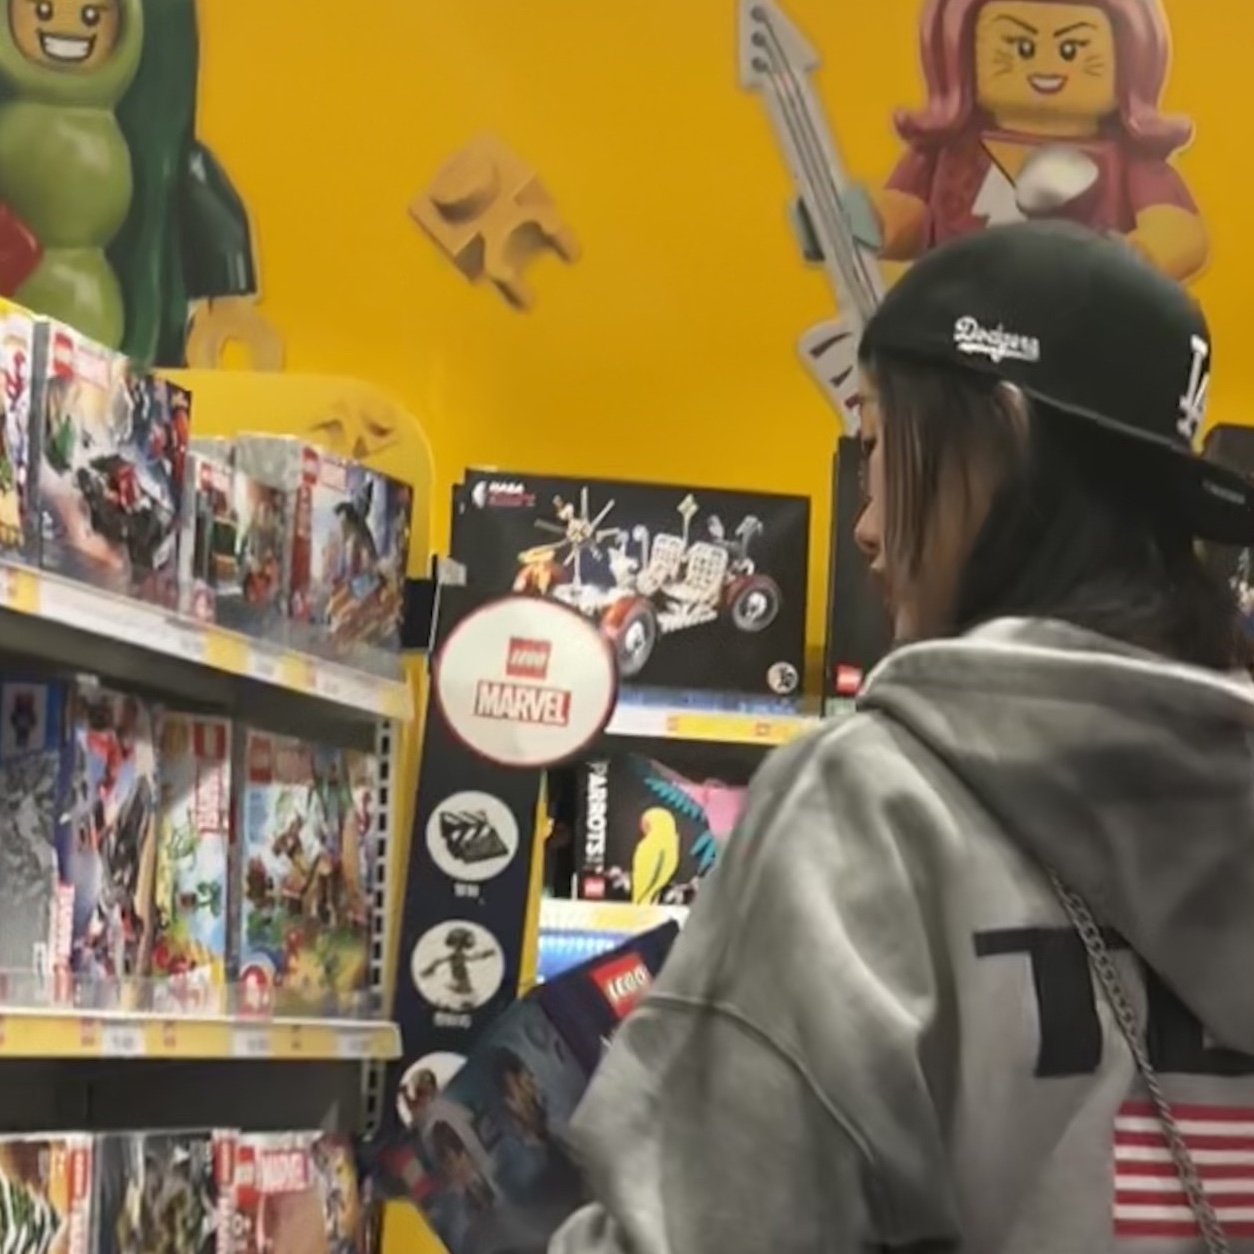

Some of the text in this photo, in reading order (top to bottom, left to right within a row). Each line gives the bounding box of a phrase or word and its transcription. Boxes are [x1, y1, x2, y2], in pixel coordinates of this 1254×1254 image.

[953, 314, 1040, 363] Dodgers
[475, 681, 569, 725] MARVEL
[586, 762, 608, 856] PARROTS
[606, 963, 650, 1002] LEGO
